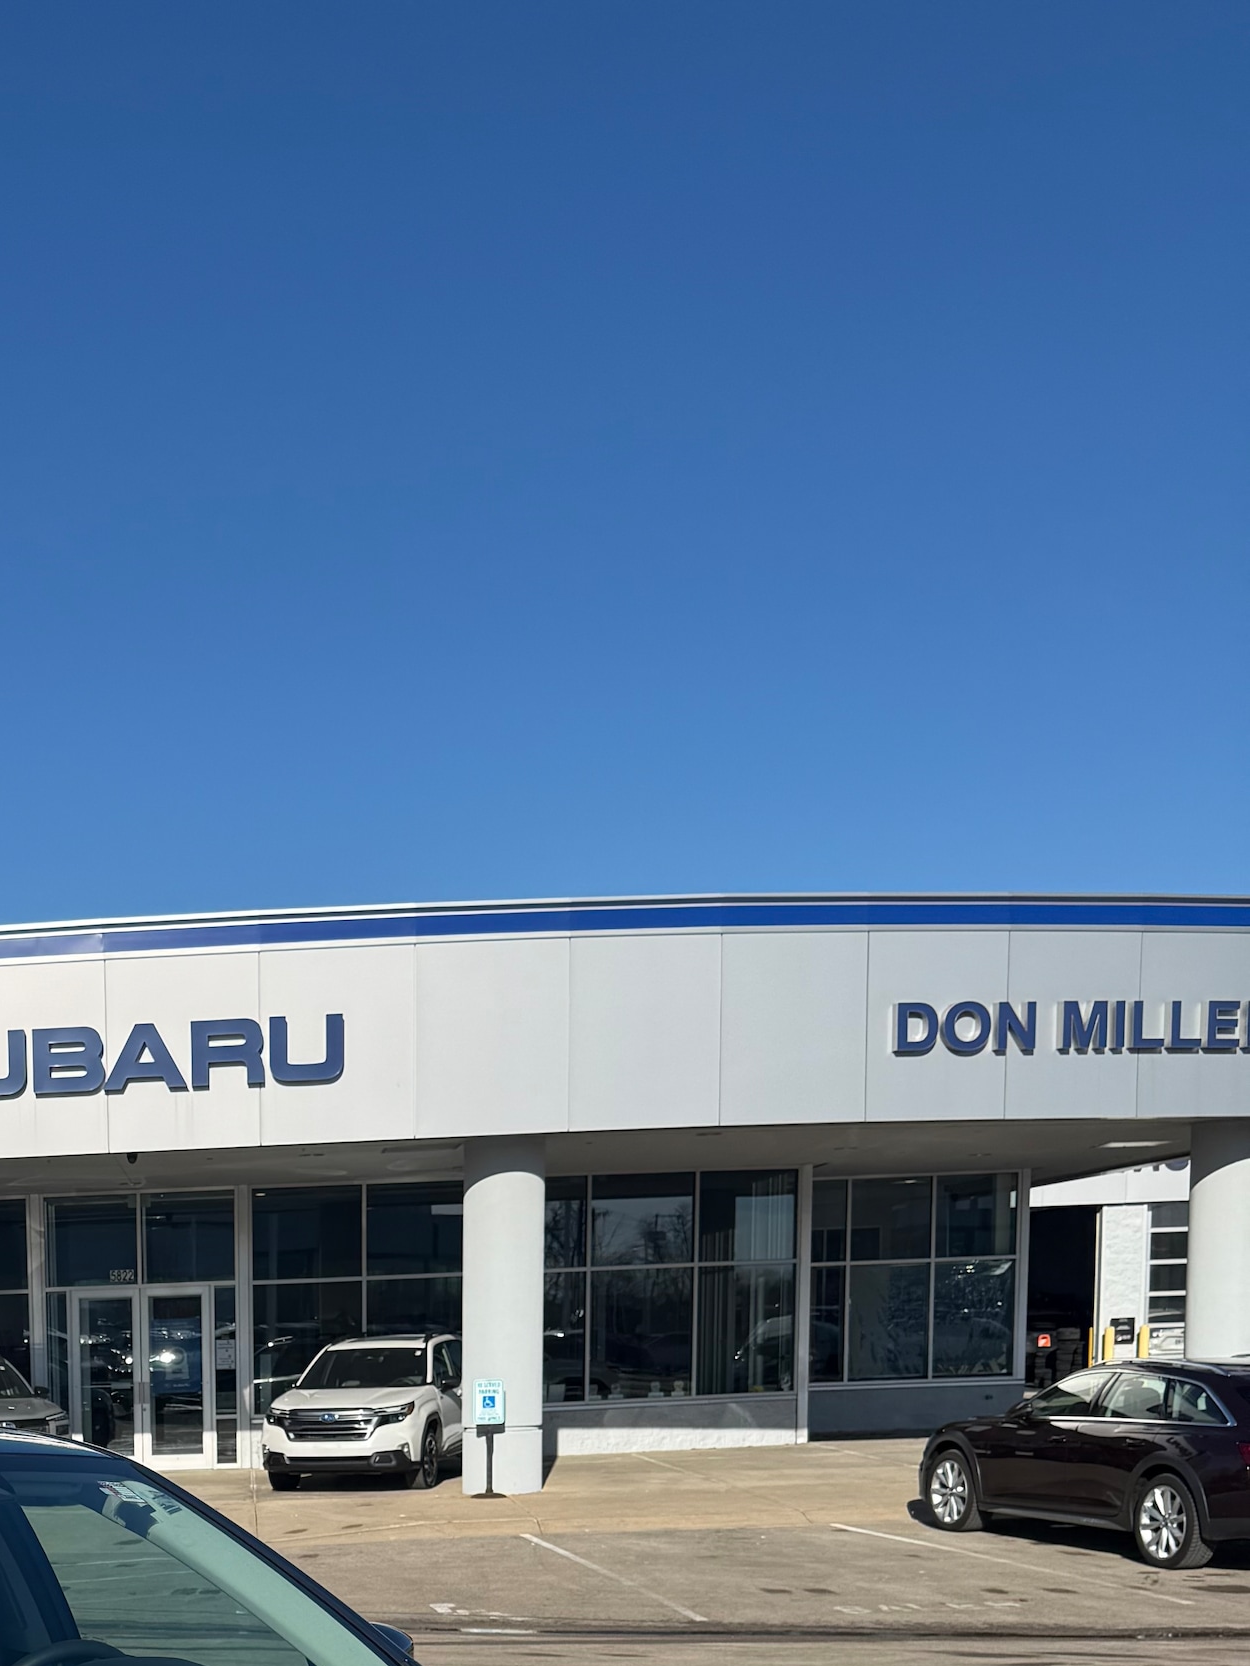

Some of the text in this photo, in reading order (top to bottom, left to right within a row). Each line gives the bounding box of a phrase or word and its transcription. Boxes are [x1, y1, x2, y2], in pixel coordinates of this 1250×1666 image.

[895, 1001, 1250, 1053] DON MILLE
[111, 1270, 134, 1281] 5822
